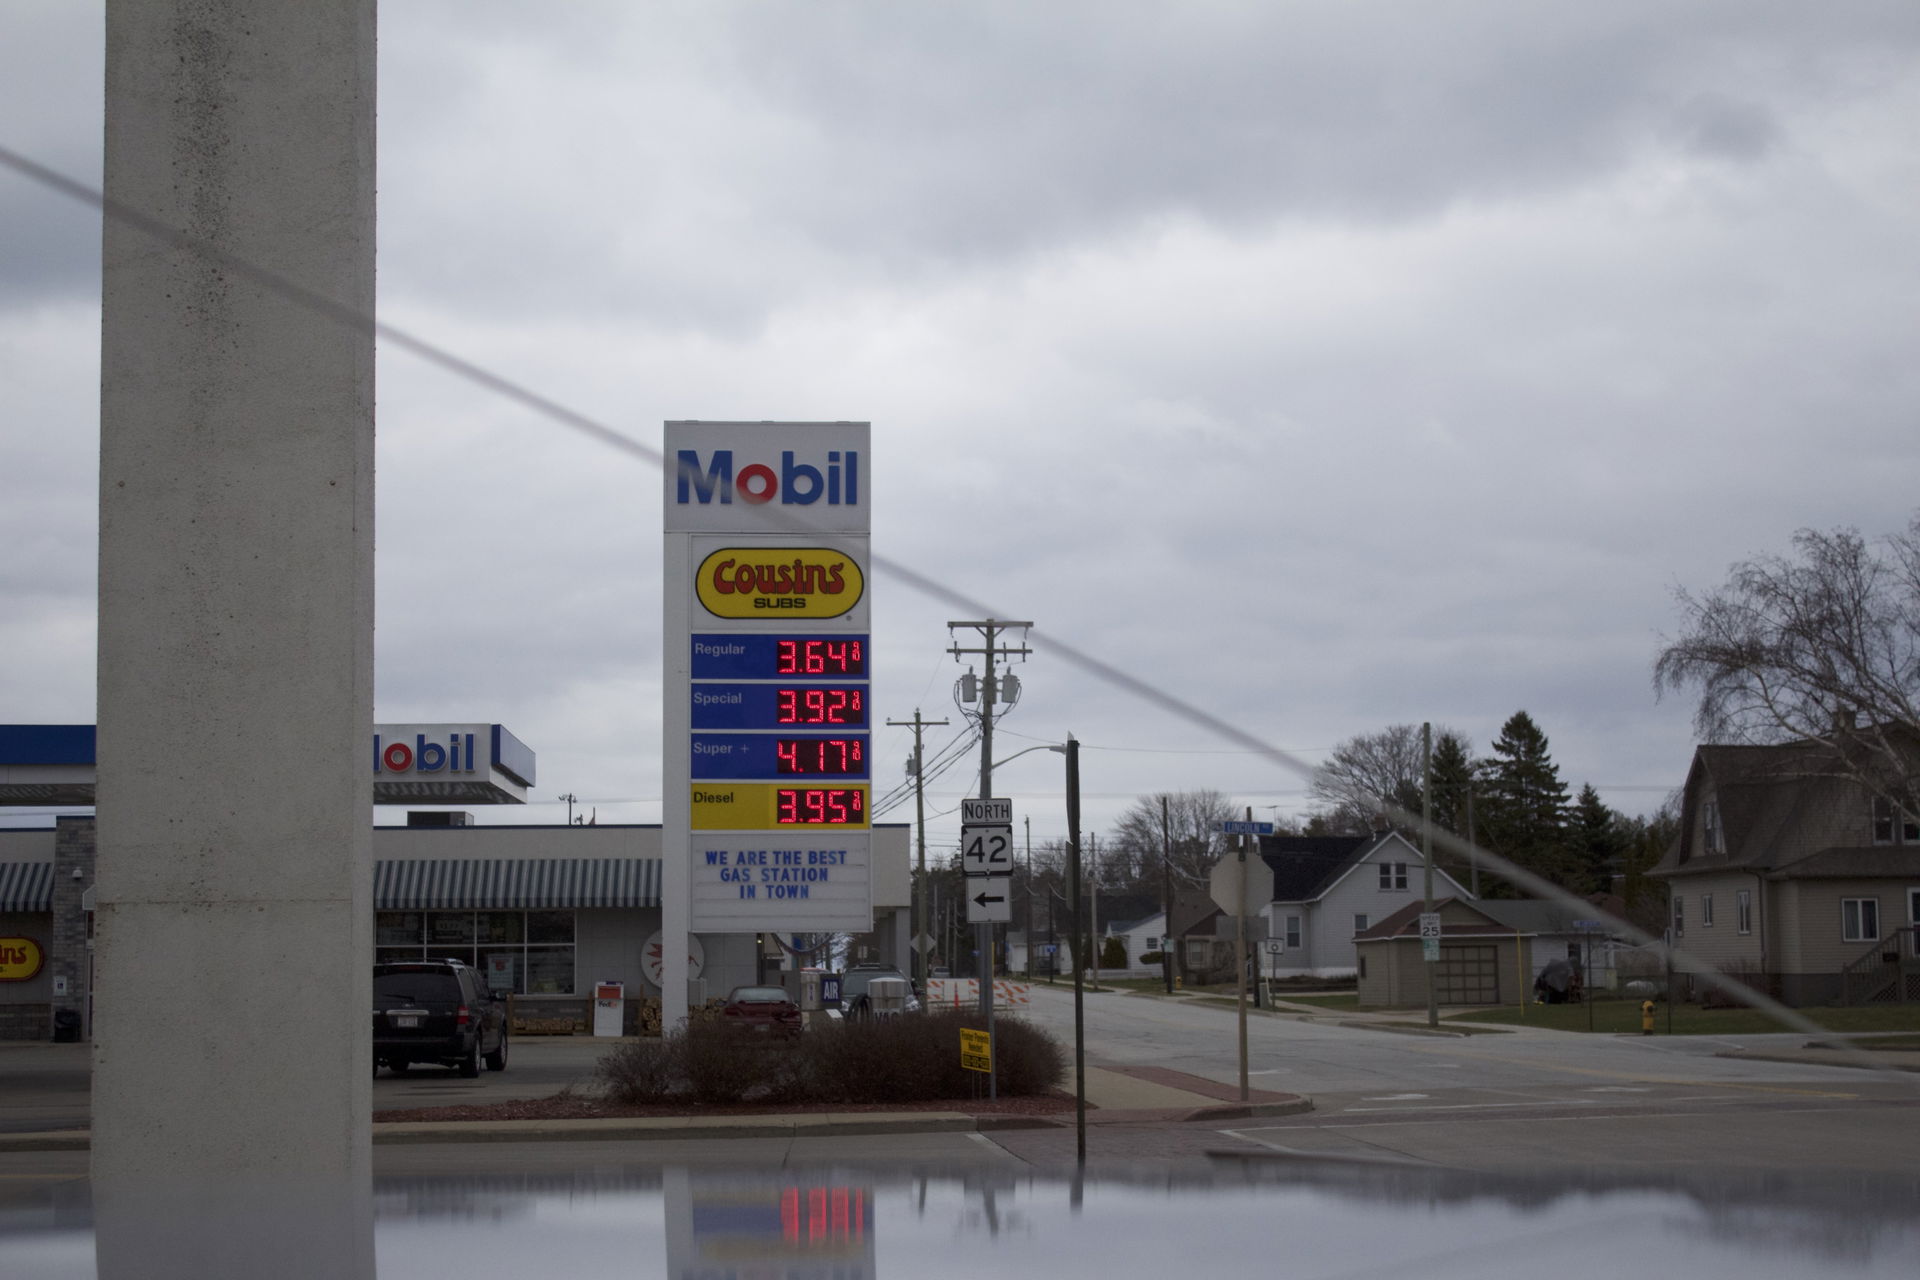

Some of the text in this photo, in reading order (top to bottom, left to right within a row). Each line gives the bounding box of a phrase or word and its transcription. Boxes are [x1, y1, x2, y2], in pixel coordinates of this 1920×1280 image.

[677, 450, 857, 505] Mobil
[713, 558, 845, 595] Cousins
[754, 598, 806, 608] SUBS
[695, 643, 746, 657] Regular
[694, 692, 742, 706] Special
[374, 733, 474, 771] obil
[693, 742, 732, 756] Super
[693, 792, 734, 804] Diesel
[965, 803, 1009, 819] NORTH
[1227, 823, 1260, 833] LINCOLN
[966, 835, 1007, 863] 42
[705, 851, 847, 865] WE ARE THE BEST
[720, 868, 829, 882] GAS STATION
[740, 885, 809, 899] IN TOWN
[1422, 926, 1440, 937] 25
[823, 981, 839, 1000] AIR
